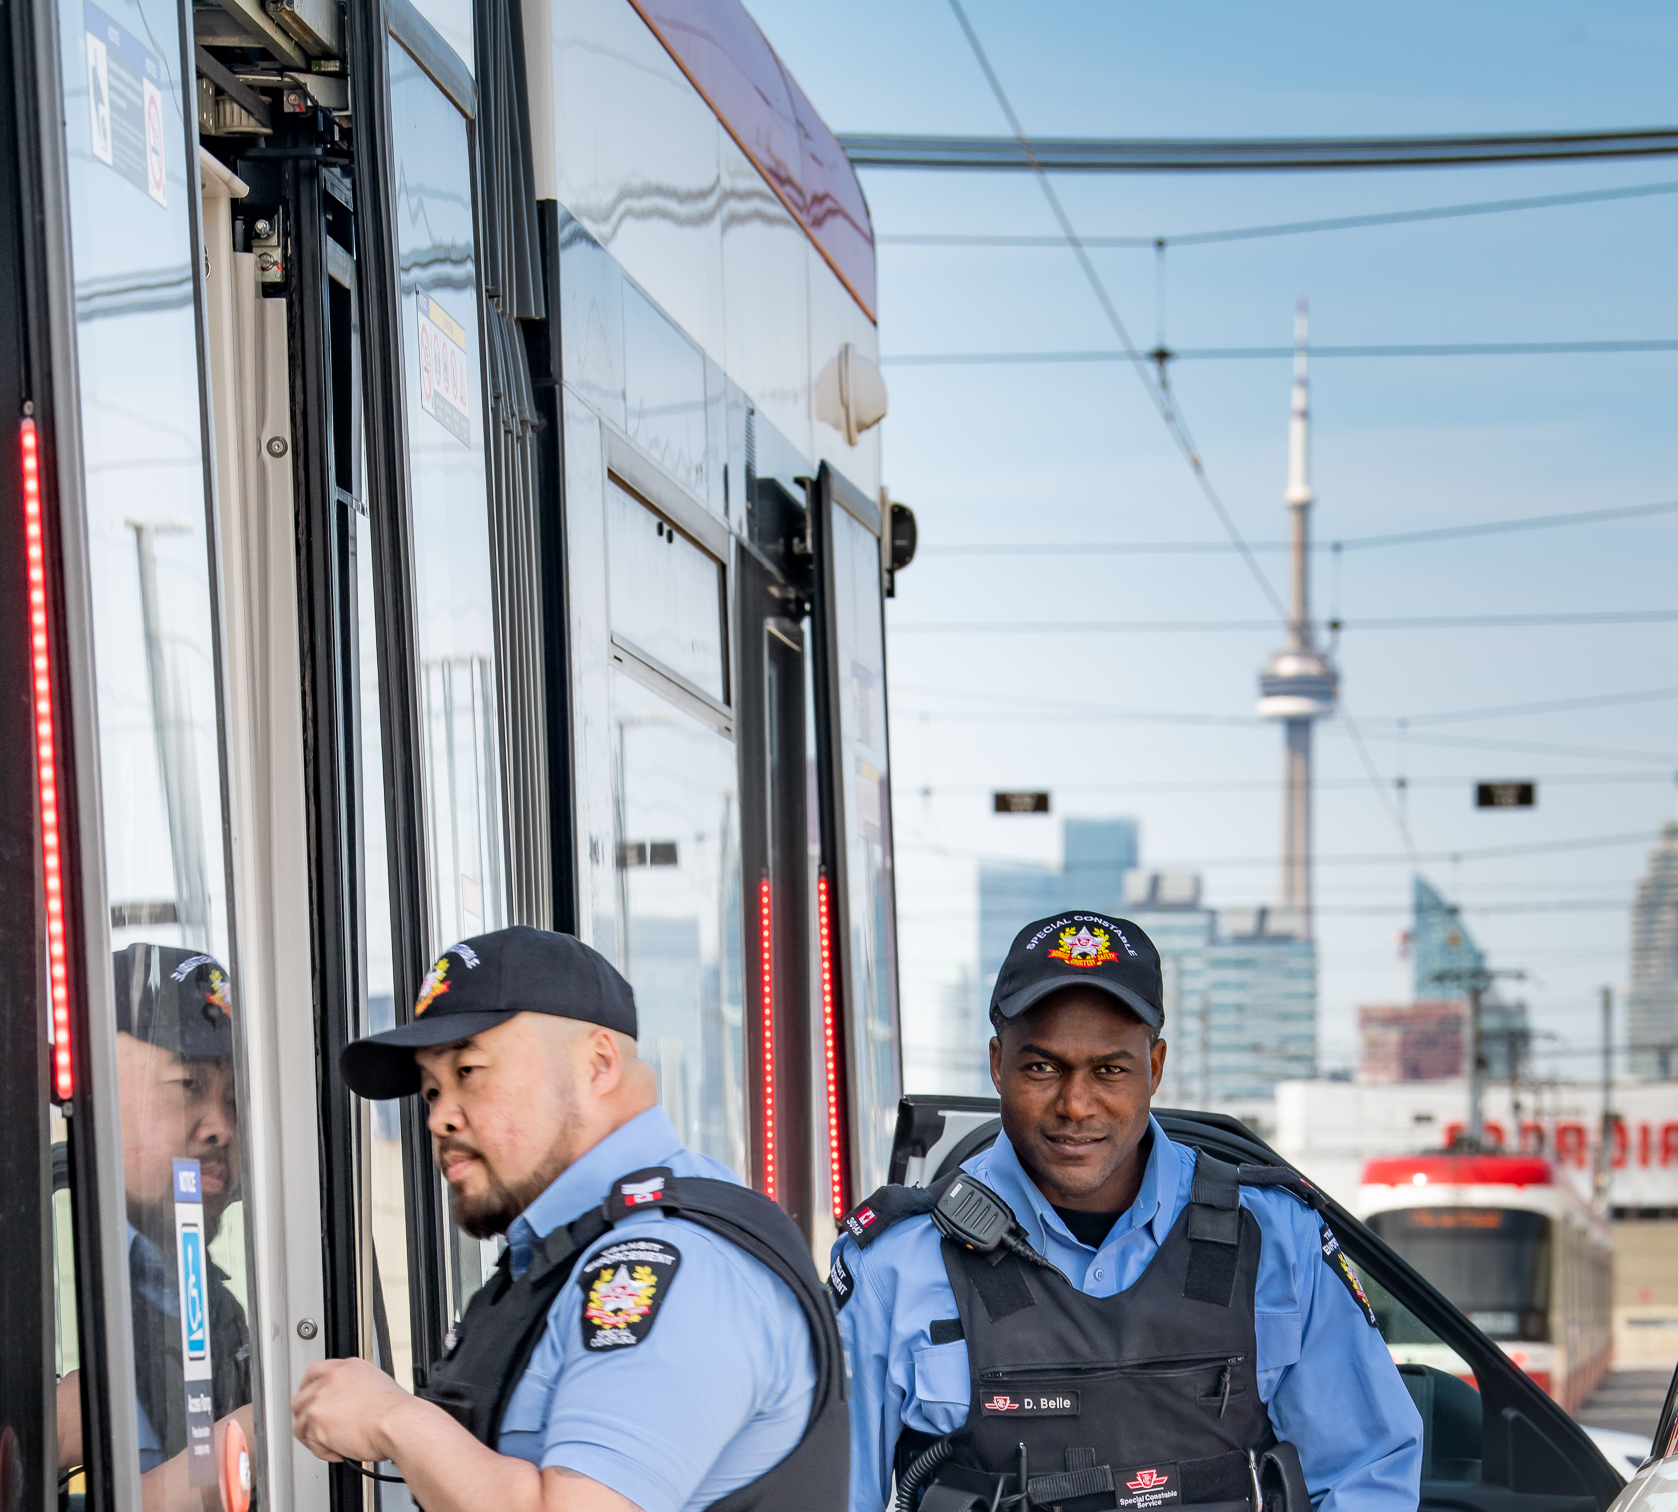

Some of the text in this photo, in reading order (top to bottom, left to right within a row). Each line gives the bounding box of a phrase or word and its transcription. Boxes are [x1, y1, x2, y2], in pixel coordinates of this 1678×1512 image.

[1026, 915, 1138, 957] SPECIAL CONSTABLE
[846, 1217, 864, 1236] 30142
[1024, 1398, 1037, 1409] D.
[1040, 1397, 1071, 1409] Belle
[1120, 1490, 1177, 1507] Special Constable
[1137, 1500, 1162, 1509] Service
